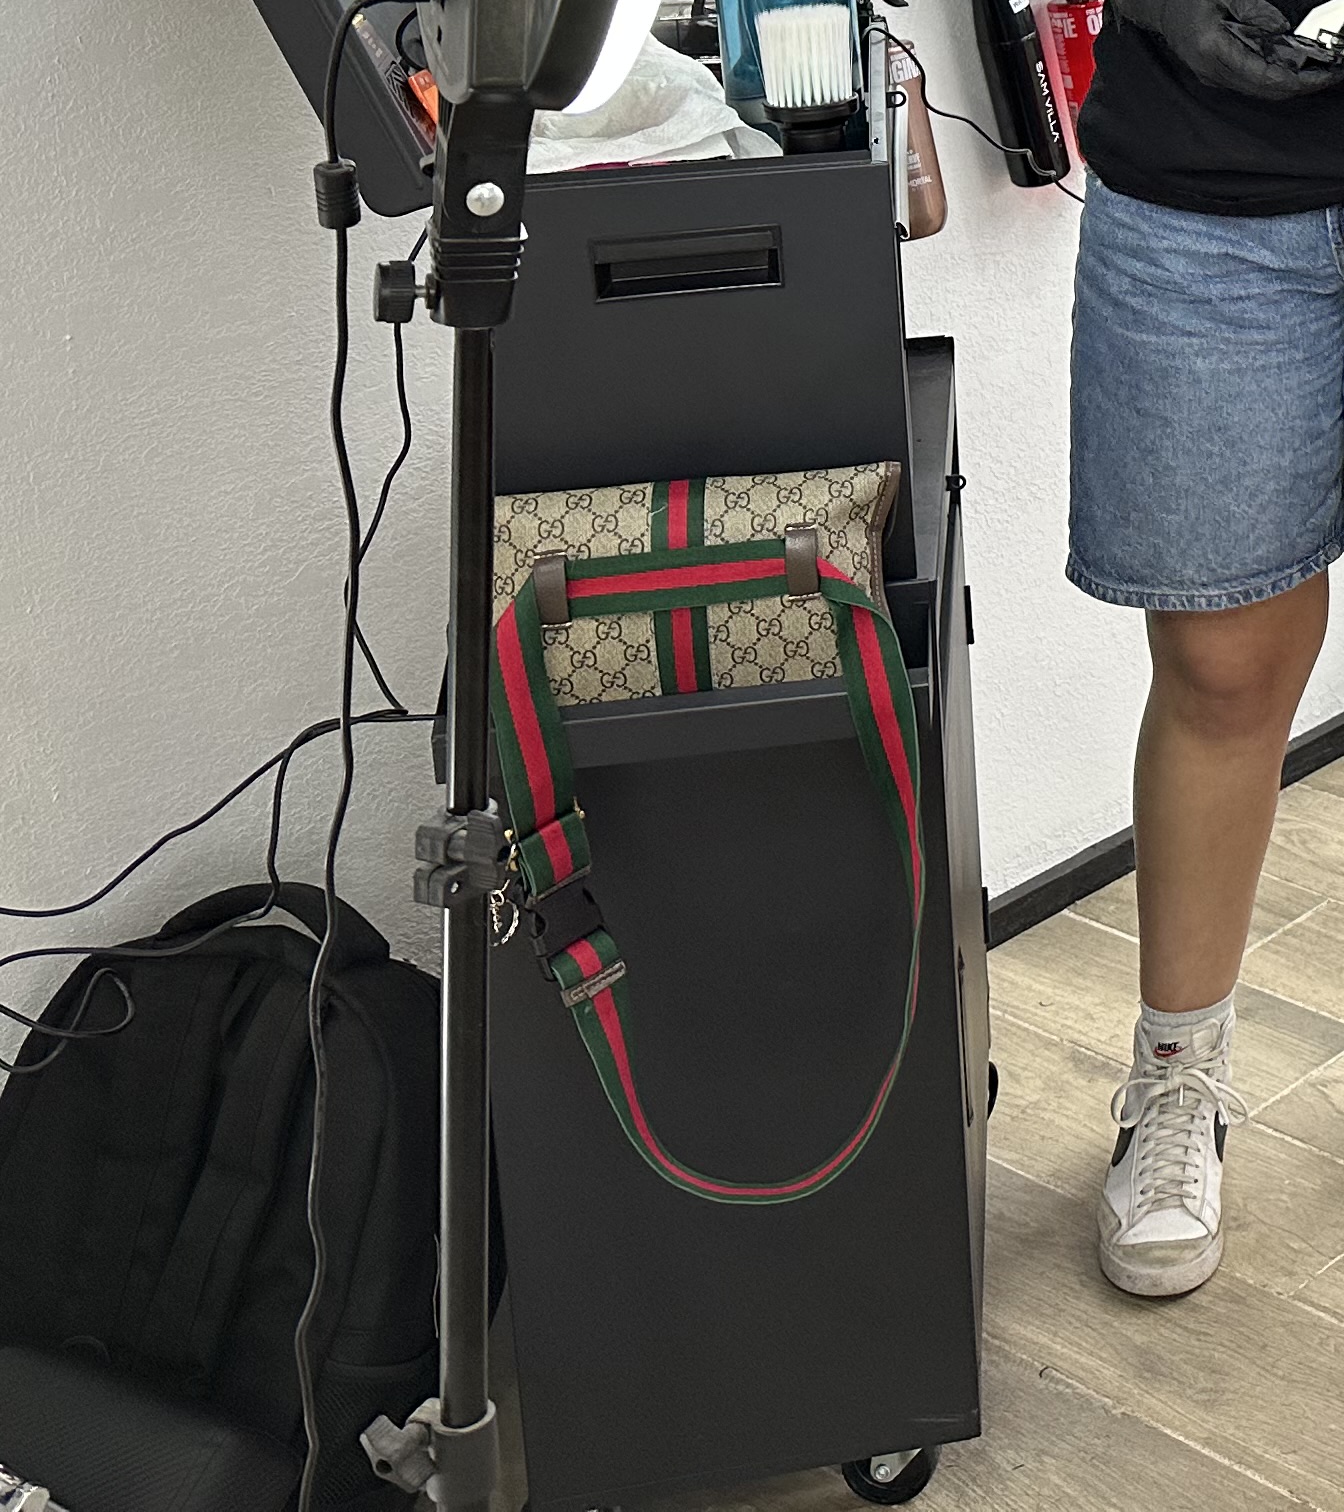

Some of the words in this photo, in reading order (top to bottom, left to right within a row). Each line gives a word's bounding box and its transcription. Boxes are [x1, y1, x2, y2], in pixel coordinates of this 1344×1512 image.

[1035, 60, 1050, 96] SAM
[1045, 96, 1060, 143] VILLA
[1157, 1041, 1180, 1052] NIKE
